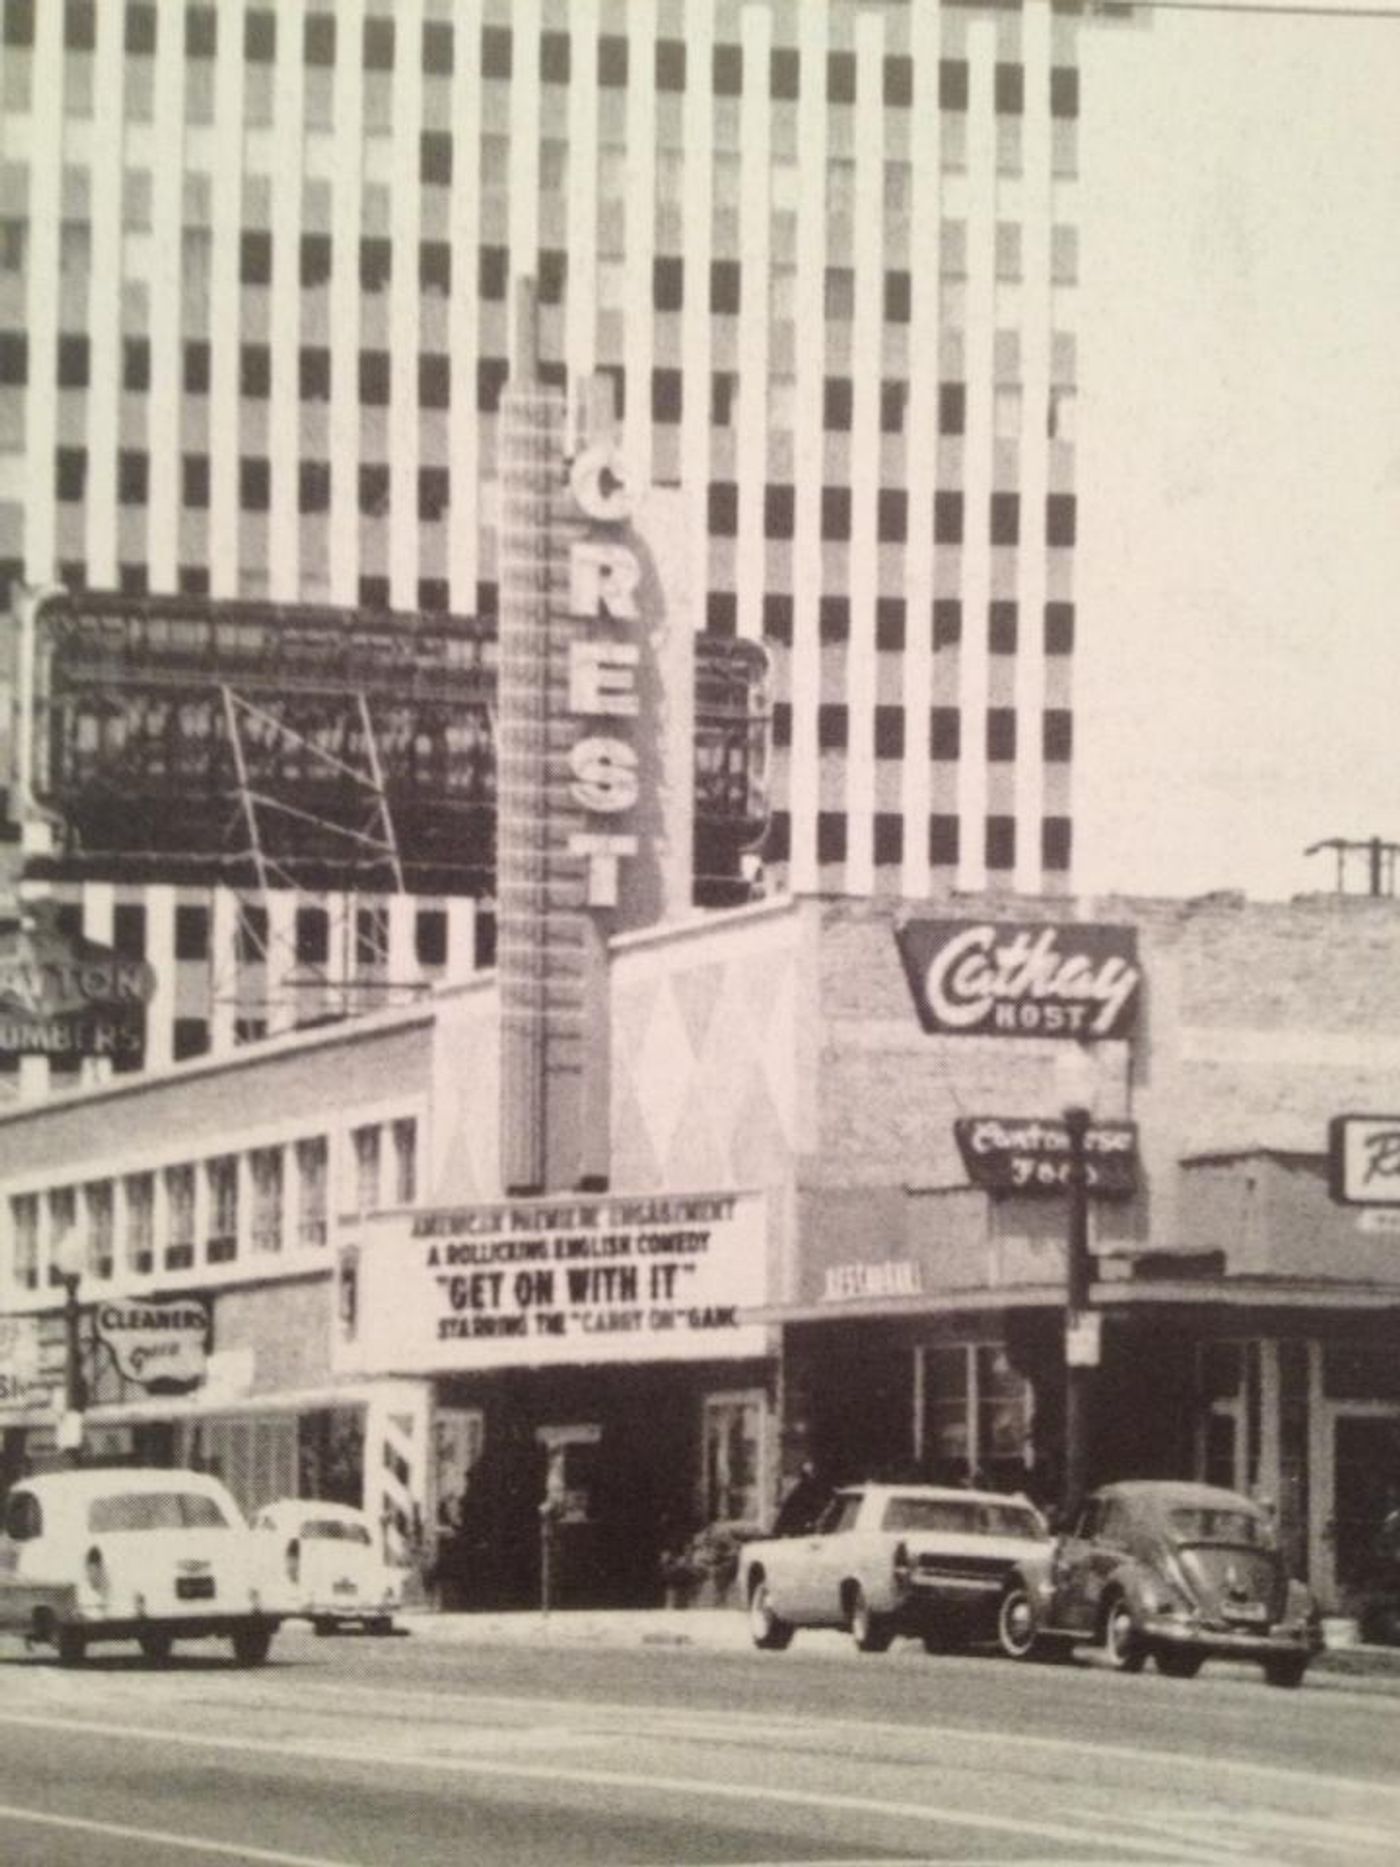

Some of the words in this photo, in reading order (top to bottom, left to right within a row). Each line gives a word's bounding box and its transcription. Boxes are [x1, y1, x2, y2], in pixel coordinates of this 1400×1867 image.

[568, 448, 641, 908] CREST
[926, 925, 1140, 1034] Cathay
[995, 1003, 1088, 1029] HOST
[427, 1244, 440, 1267] A
[446, 1239, 548, 1265] ROLLICKING
[554, 1235, 631, 1261] ENGLISH
[636, 1230, 711, 1255] COMEDY
[514, 1269, 554, 1308] ON
[566, 1265, 638, 1305] WITH
[651, 1262, 696, 1302] IT"
[101, 1306, 207, 1331] CLEANERS
[438, 1314, 528, 1340] STARRING
[535, 1311, 566, 1336] THE
